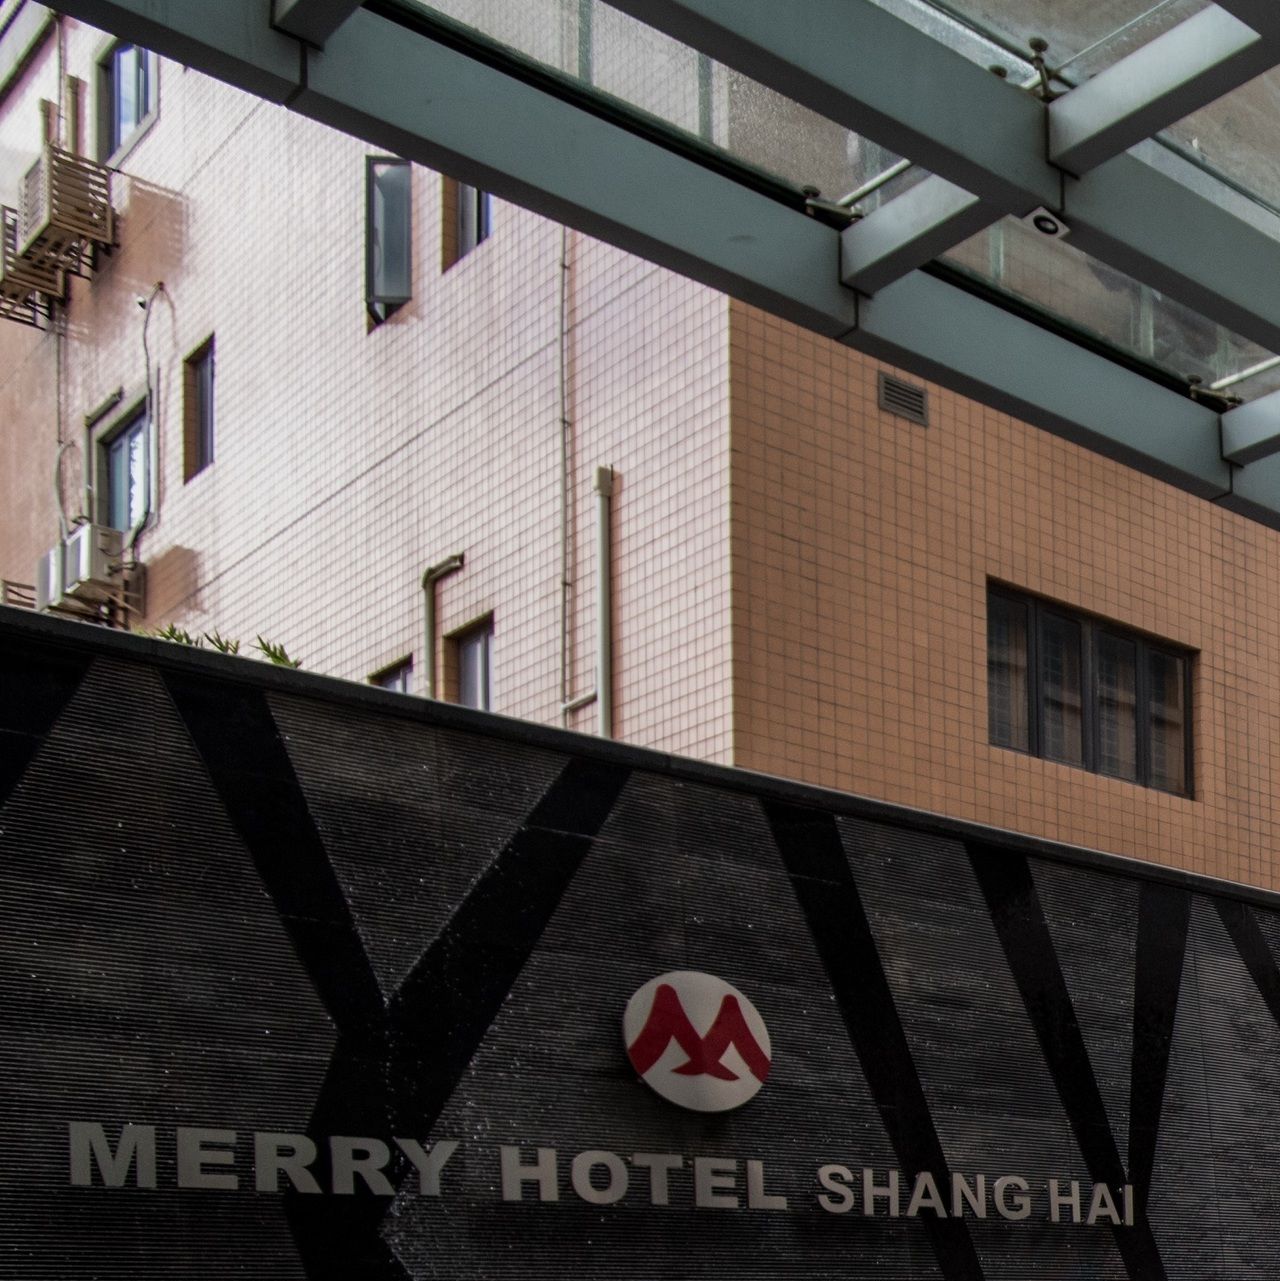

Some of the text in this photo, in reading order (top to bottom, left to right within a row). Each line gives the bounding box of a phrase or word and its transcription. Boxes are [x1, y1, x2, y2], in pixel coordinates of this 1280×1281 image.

[69, 1121, 1135, 1227] MERRY HOTEL SHANG HAI
